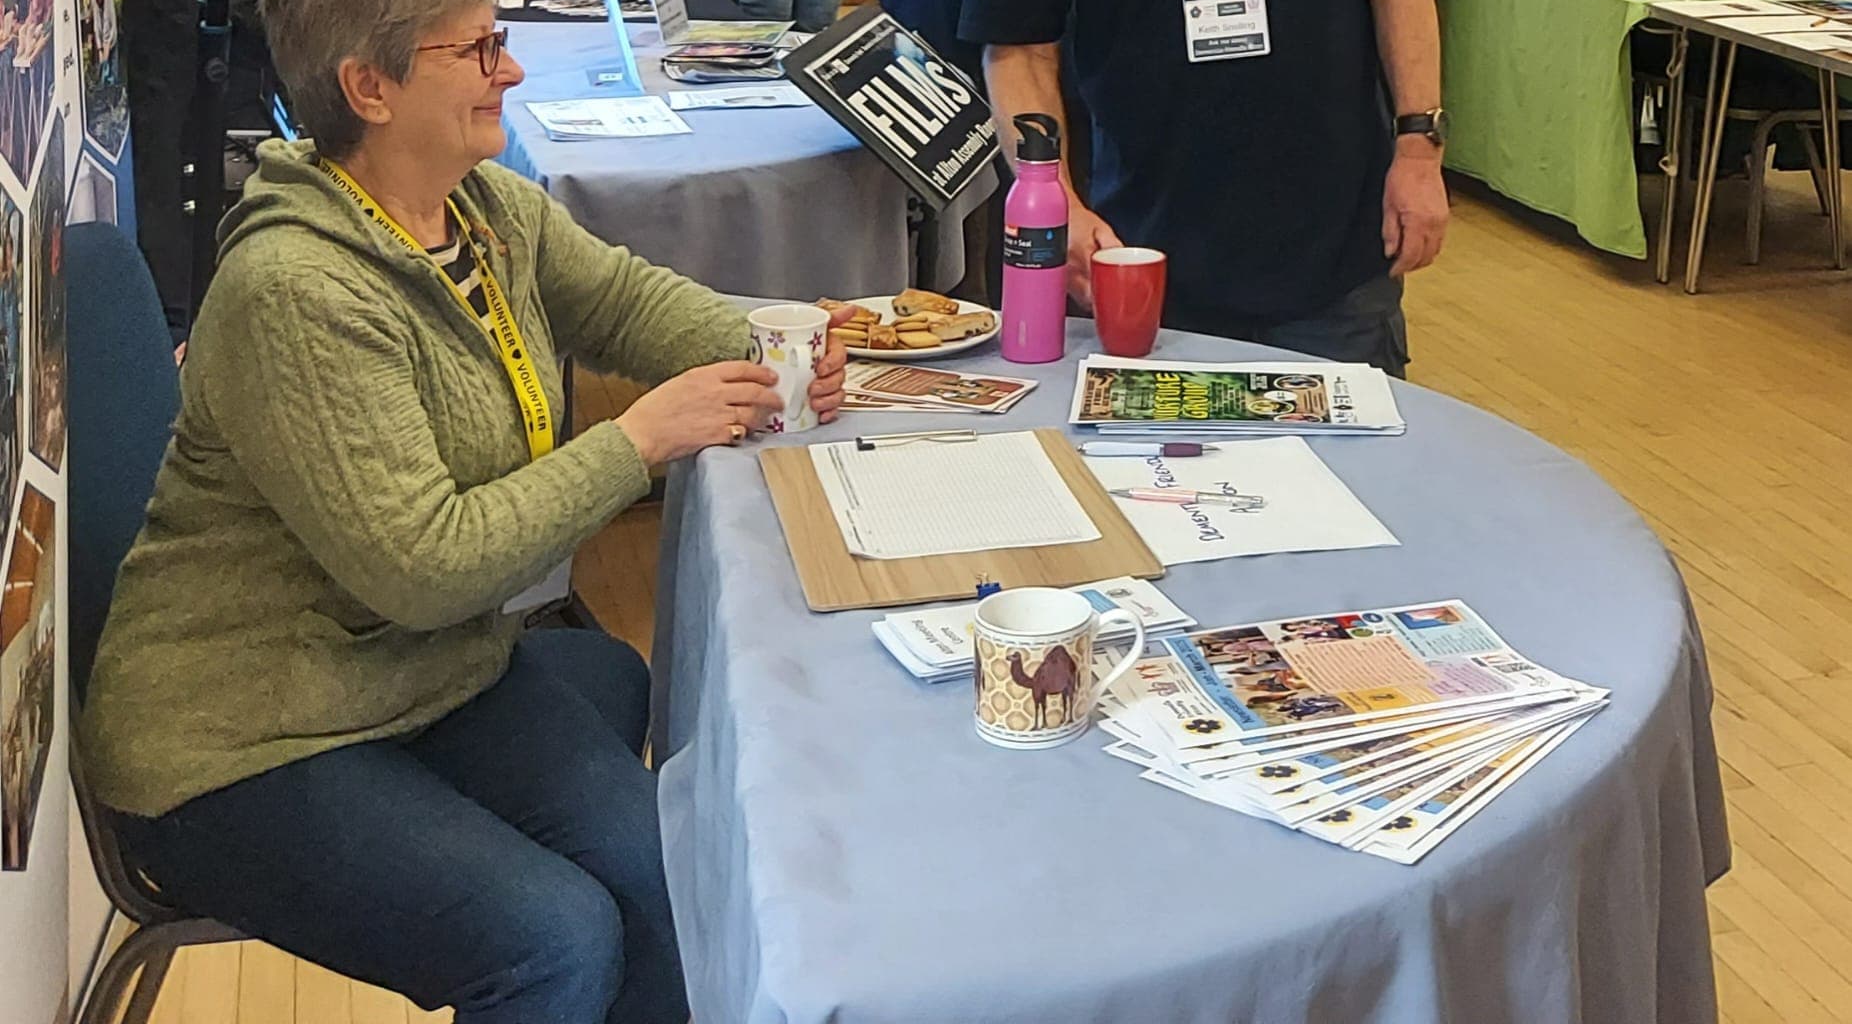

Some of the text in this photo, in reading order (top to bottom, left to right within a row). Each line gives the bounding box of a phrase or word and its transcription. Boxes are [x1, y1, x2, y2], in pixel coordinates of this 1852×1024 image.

[846, 55, 972, 159] FILMS
[931, 170, 948, 187] at
[951, 130, 988, 165] Assembly
[485, 279, 547, 432] VOLUNTEER VOLUNTEER
